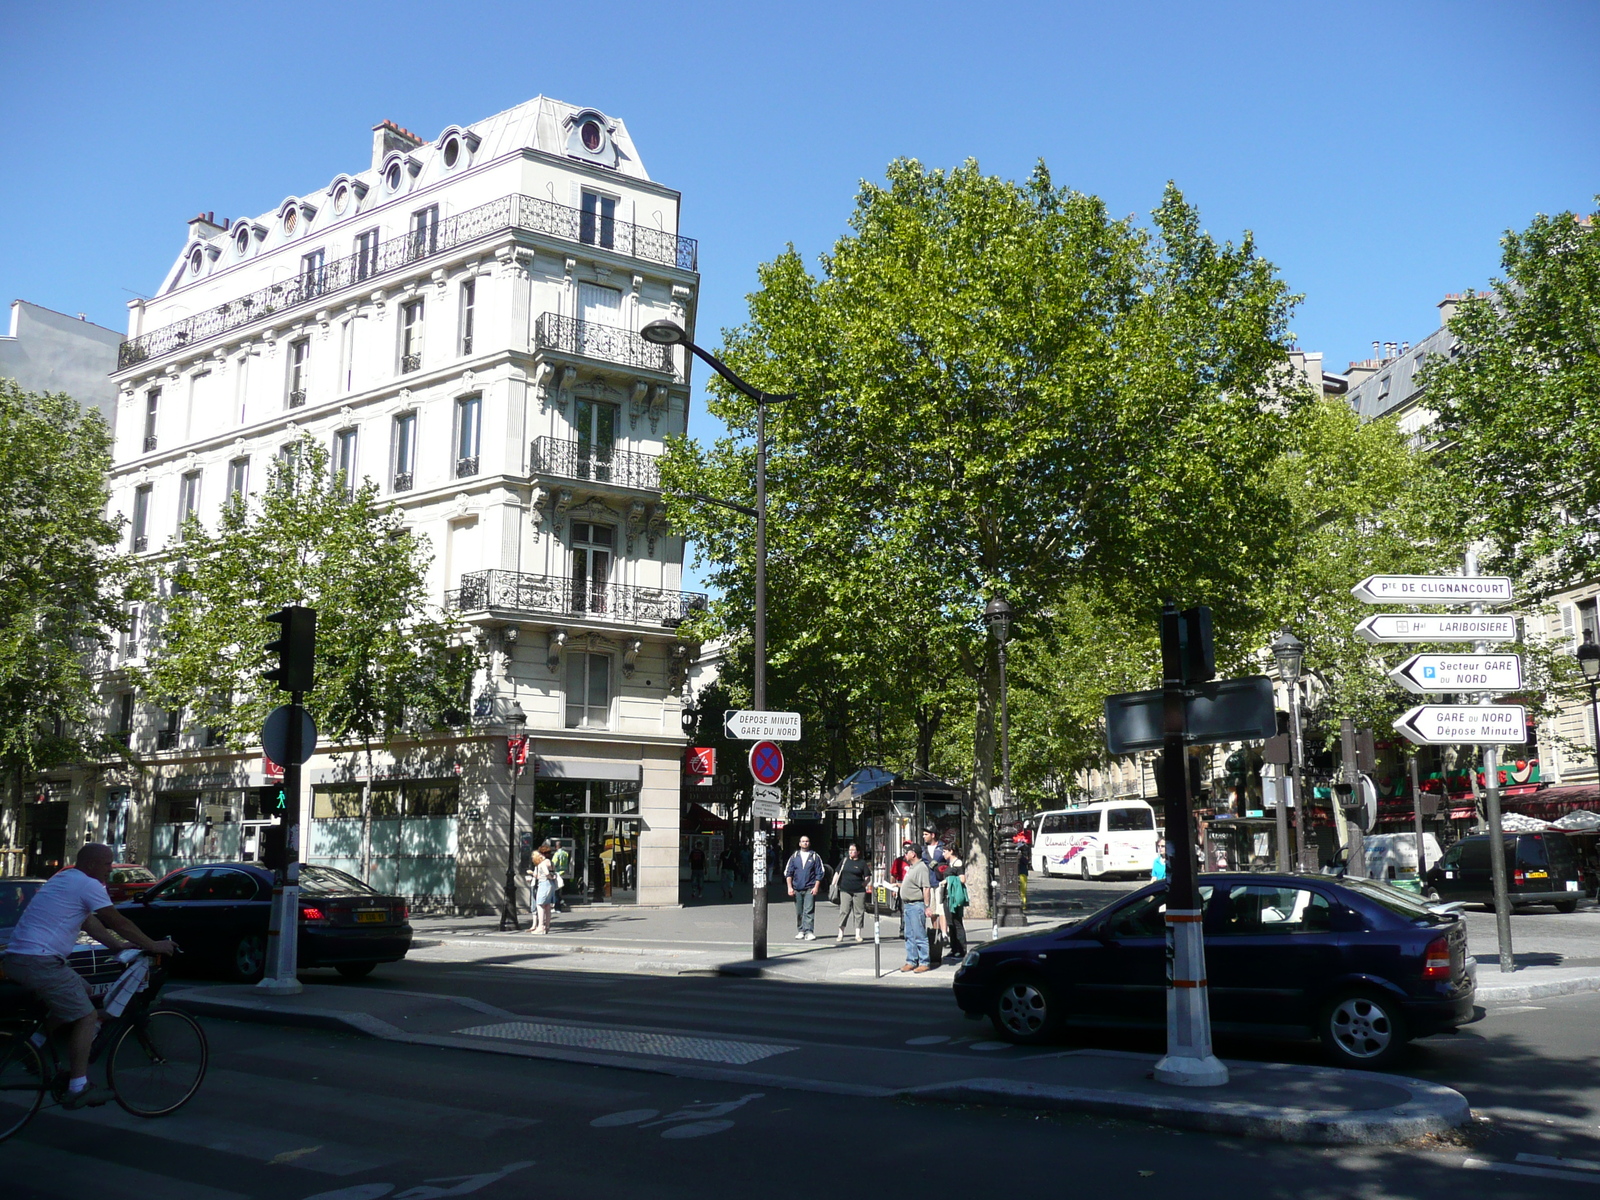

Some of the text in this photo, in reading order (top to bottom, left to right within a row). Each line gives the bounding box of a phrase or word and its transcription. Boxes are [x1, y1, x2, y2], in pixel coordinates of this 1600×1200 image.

[1402, 584, 1415, 592] DE
[1421, 584, 1504, 593] CLIGNANCOURT
[1439, 622, 1508, 632] LARIBOISIERE
[1439, 661, 1512, 671] Secteur GARE
[1457, 674, 1487, 683] NORD
[771, 717, 798, 725] MINUTE
[1436, 712, 1465, 722] GARE
[1482, 713, 1512, 722] NORD
[741, 727, 797, 736] GARE DU NORD
[1437, 725, 1519, 737] Dépose Minute
